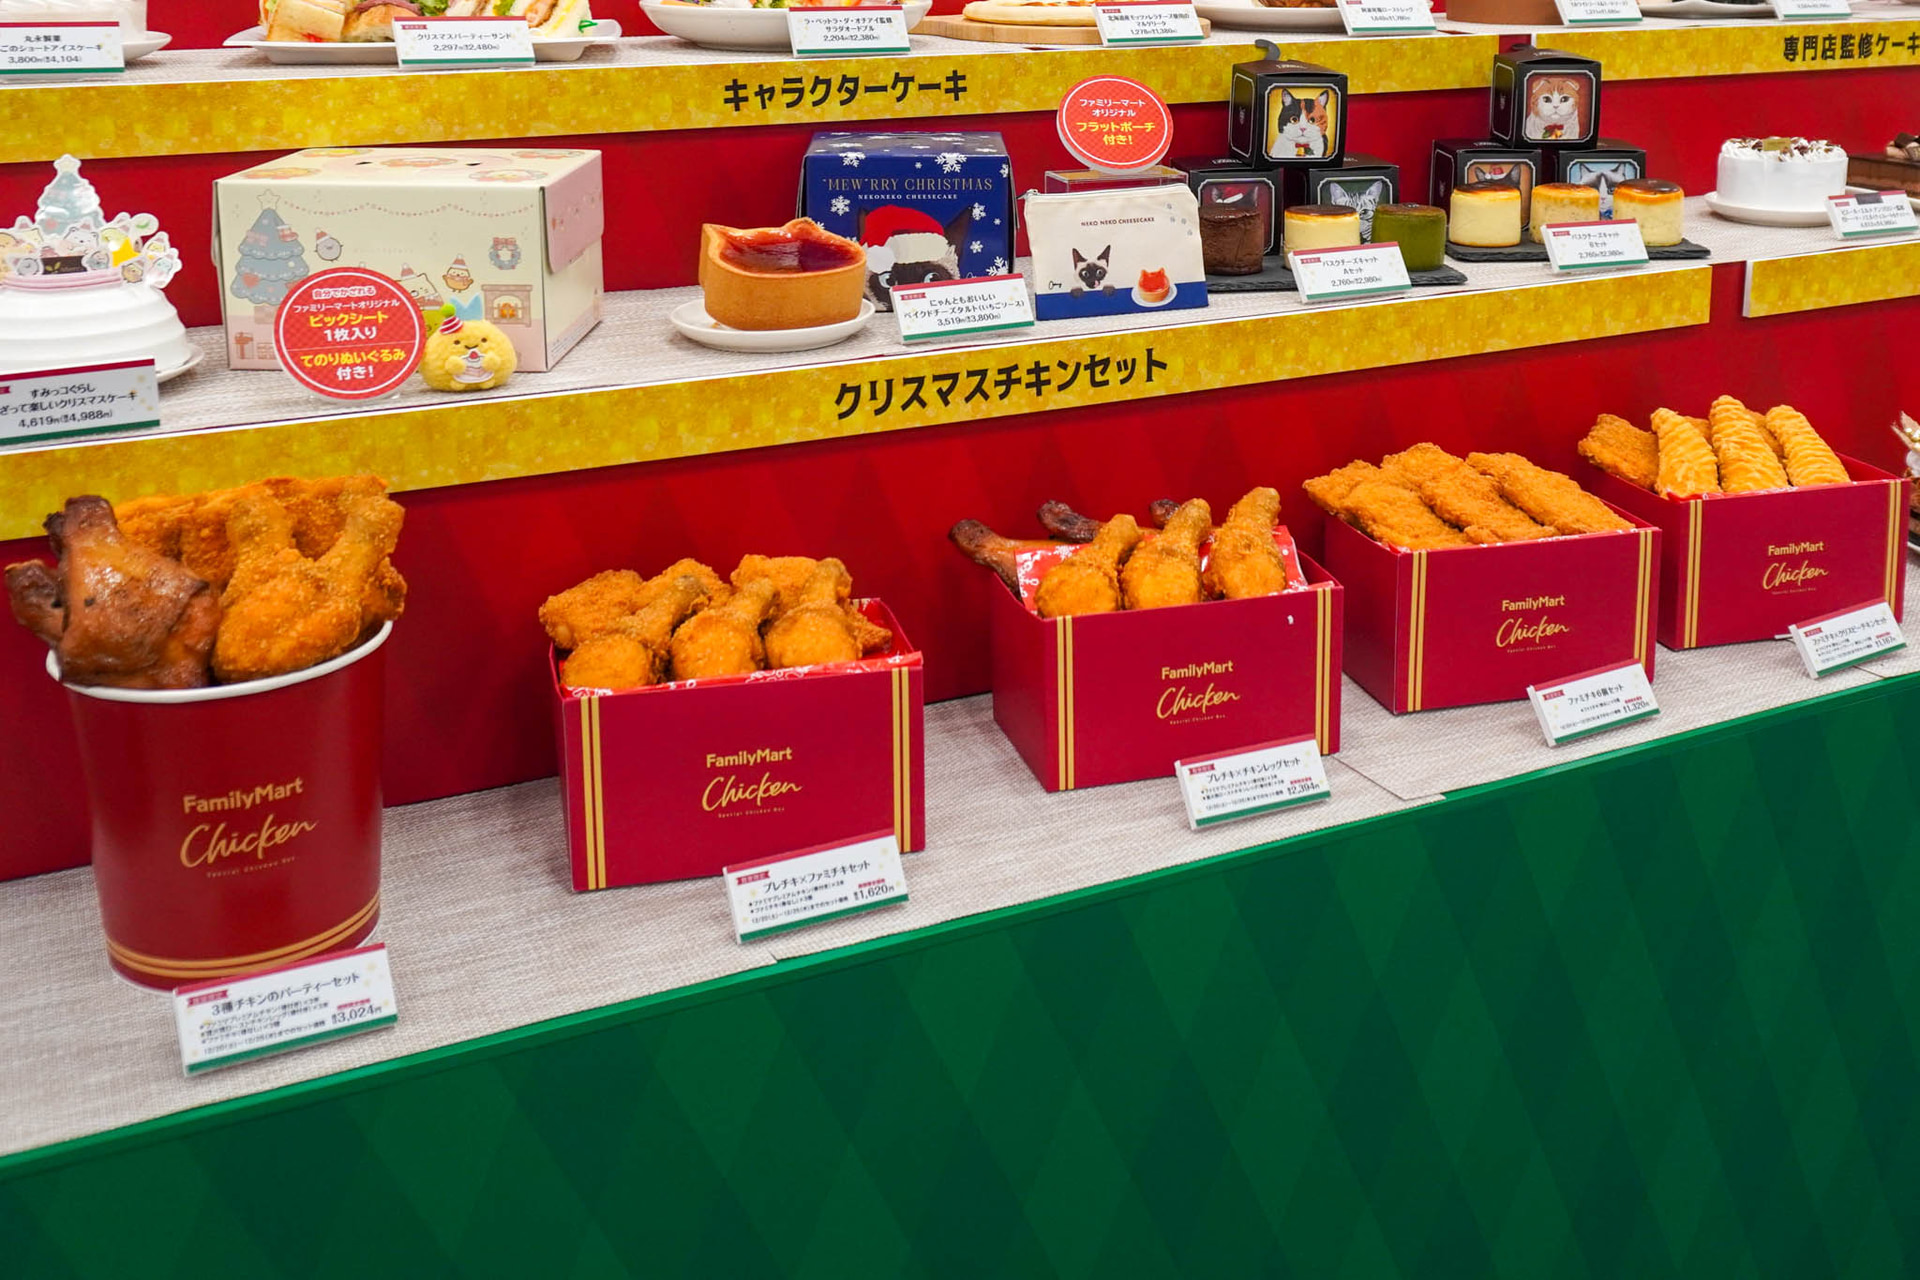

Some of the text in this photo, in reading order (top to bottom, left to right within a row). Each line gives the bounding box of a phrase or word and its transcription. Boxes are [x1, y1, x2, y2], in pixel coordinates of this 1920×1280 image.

[1783, 32, 1920, 62] 専門店監修ケーキ
[723, 69, 968, 112] キャラクターケーキ
[1080, 99, 1146, 107] ファミリーマート
[1092, 109, 1136, 117] オリジナル
[1076, 121, 1155, 132] フラットポーチ
[905, 178, 992, 191] CHRISTMAS
[1119, 217, 1155, 225] CHEESECAKE
[313, 286, 376, 299] 自分でかざれる
[930, 294, 996, 307] にゃんともおいしい
[293, 299, 400, 313] ファミリーマートオリジナル
[324, 326, 377, 342] 1枚入り
[300, 349, 406, 367] てのりぬいぐるみ
[31, 383, 96, 398] すみっコぐらし
[835, 348, 1167, 420] クリスマスチキンセット
[1767, 541, 1824, 556] FamilyMart
[1763, 560, 1829, 590] Chicken
[1501, 595, 1565, 611] FamilyMart
[1496, 615, 1570, 647] Chicken
[1161, 660, 1234, 680] FamilyMart
[1156, 682, 1240, 719] Chicken
[706, 746, 792, 768] FamilyMart
[182, 777, 303, 814] FamilyMart
[702, 772, 802, 811] Chicken
[180, 813, 319, 868] Chicken
[764, 860, 871, 894] プレチキ×ファミチキセット
[211, 972, 360, 1016] 3種チキンのパーティーセット
